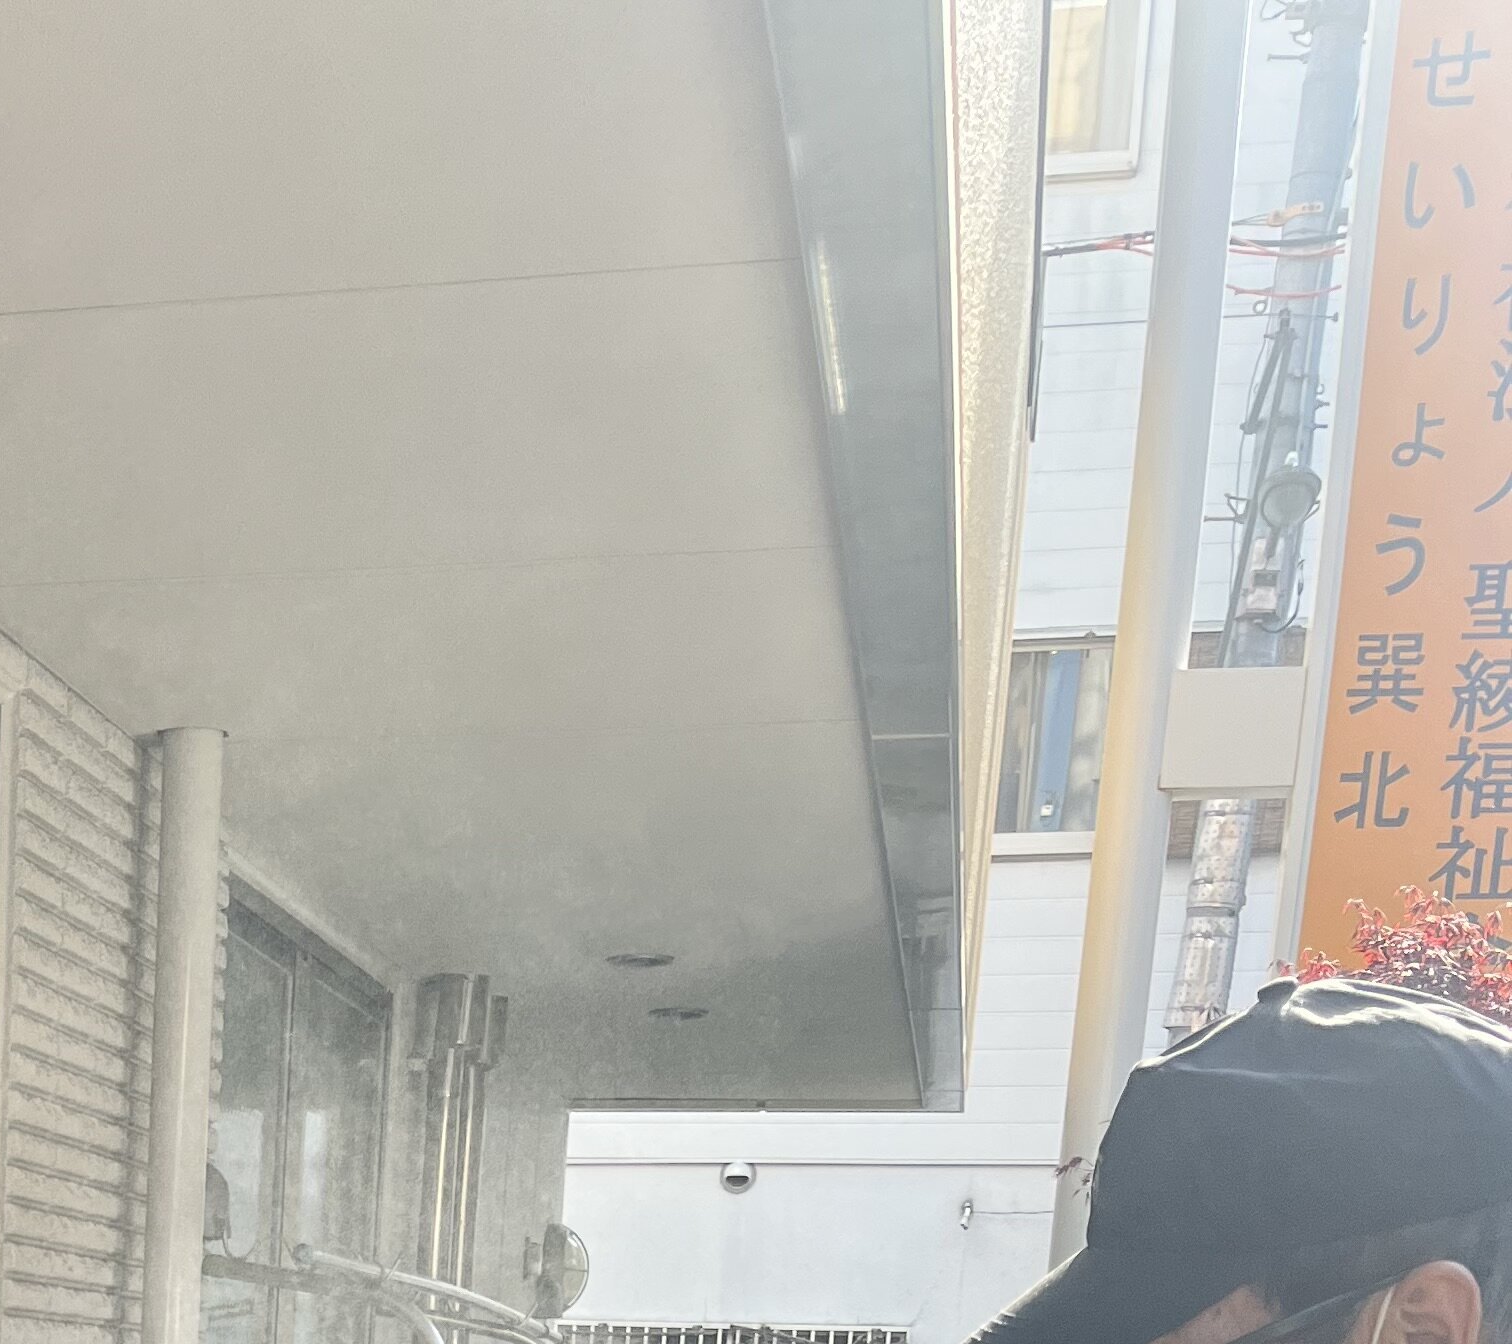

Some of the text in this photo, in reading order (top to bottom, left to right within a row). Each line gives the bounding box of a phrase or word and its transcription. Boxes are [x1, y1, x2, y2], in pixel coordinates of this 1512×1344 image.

[1334, 31, 1492, 829] せいりょう巽北
